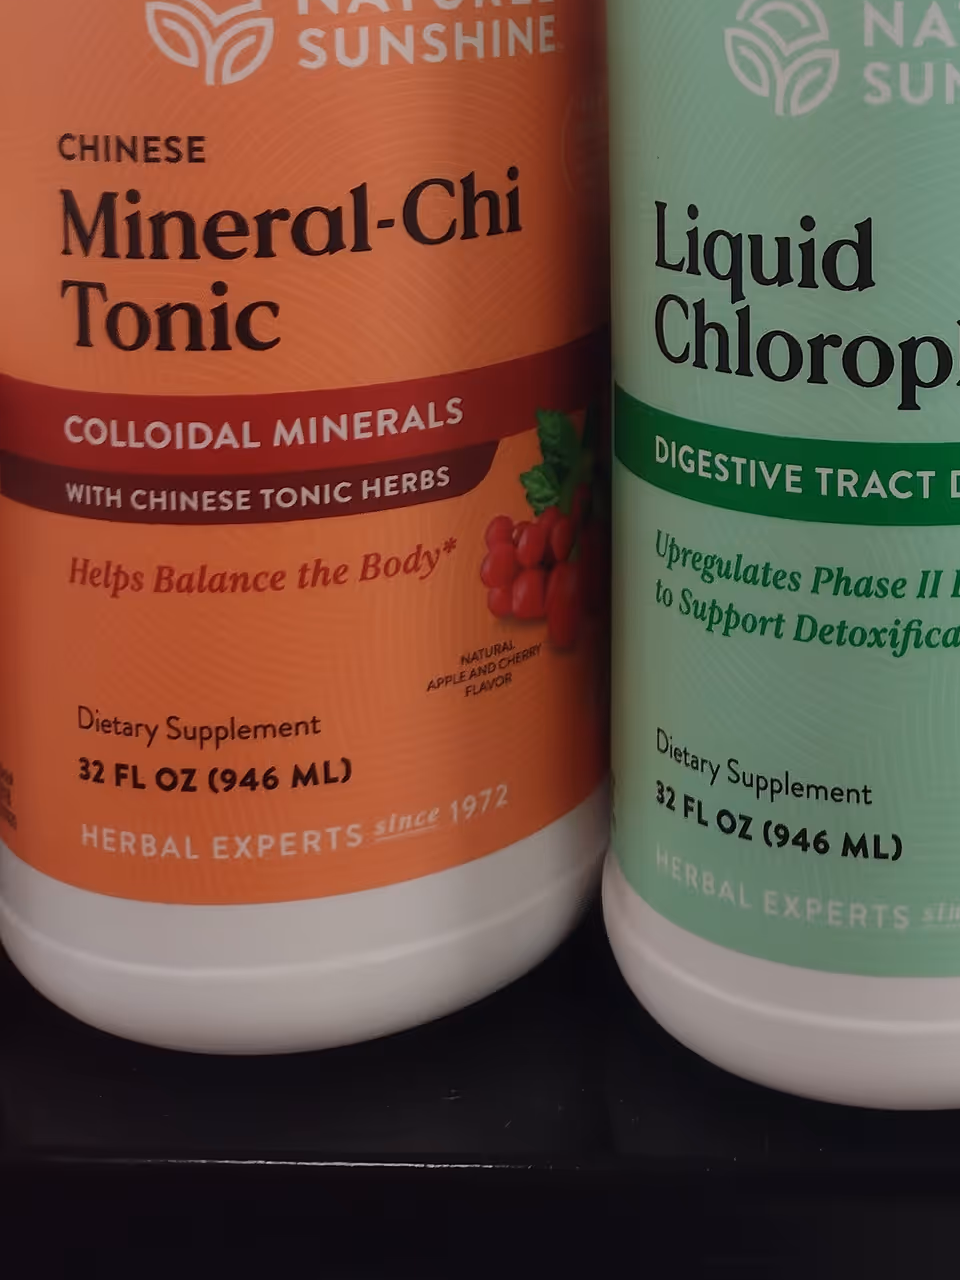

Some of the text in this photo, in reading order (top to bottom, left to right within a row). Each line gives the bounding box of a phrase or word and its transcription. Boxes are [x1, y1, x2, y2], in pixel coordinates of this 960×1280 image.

[298, 15, 556, 69] SUNSHINE
[58, 133, 206, 163] CHINESE
[60, 166, 522, 260] Mineral-Chi
[655, 201, 876, 304] Liquid
[61, 280, 281, 351] Tonic
[64, 397, 464, 450] COLLOIDAL MINERALS
[66, 466, 451, 512] WITH CHINESE TONIC HERBS
[655, 435, 802, 494] DIGESTIVE
[815, 468, 936, 499] TRACT
[69, 557, 145, 598] Helps
[153, 564, 286, 594] Balance
[298, 559, 349, 588] the
[655, 530, 801, 594] Upregulates
[810, 565, 906, 599] Phase
[916, 570, 943, 599] II
[655, 578, 673, 608] to
[678, 588, 785, 641] Support
[426, 642, 542, 692] APPLE AND CHERRY
[461, 640, 515, 665] NATURAL
[464, 672, 512, 697] FLAVOR
[77, 706, 321, 749] Dietary Supplement
[78, 757, 353, 794] 32 FL OZ (946 ML)
[656, 728, 872, 804] Dietary Supplement
[81, 785, 508, 860] HERBAL EXPERTS since 1972
[655, 781, 903, 862] 32 FL OZ (946 ML)
[655, 848, 753, 909] HERBAL
[763, 890, 910, 929] EXPERTS
